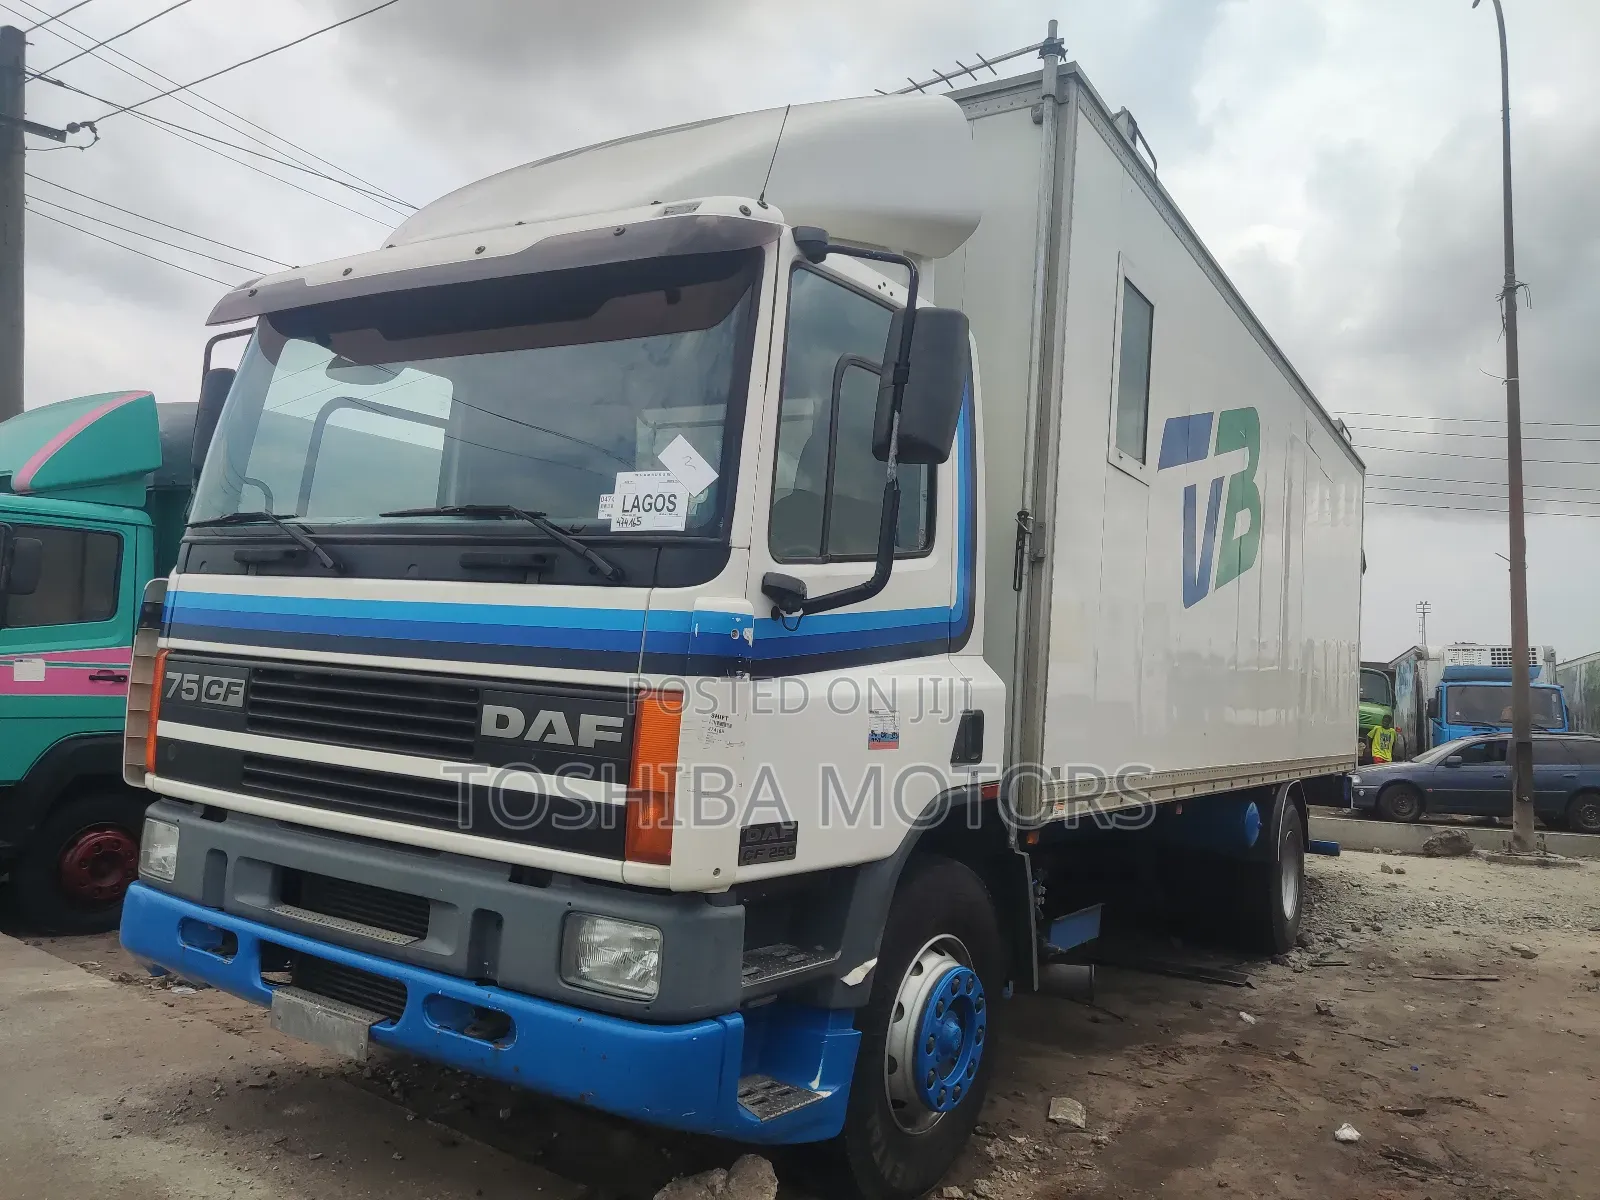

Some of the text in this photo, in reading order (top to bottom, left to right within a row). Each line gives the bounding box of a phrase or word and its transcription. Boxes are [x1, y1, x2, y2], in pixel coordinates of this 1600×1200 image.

[621, 493, 678, 514] LAGOS
[480, 703, 625, 749] DAF
[745, 826, 794, 843] DAF
[743, 846, 795, 862] CF 250
